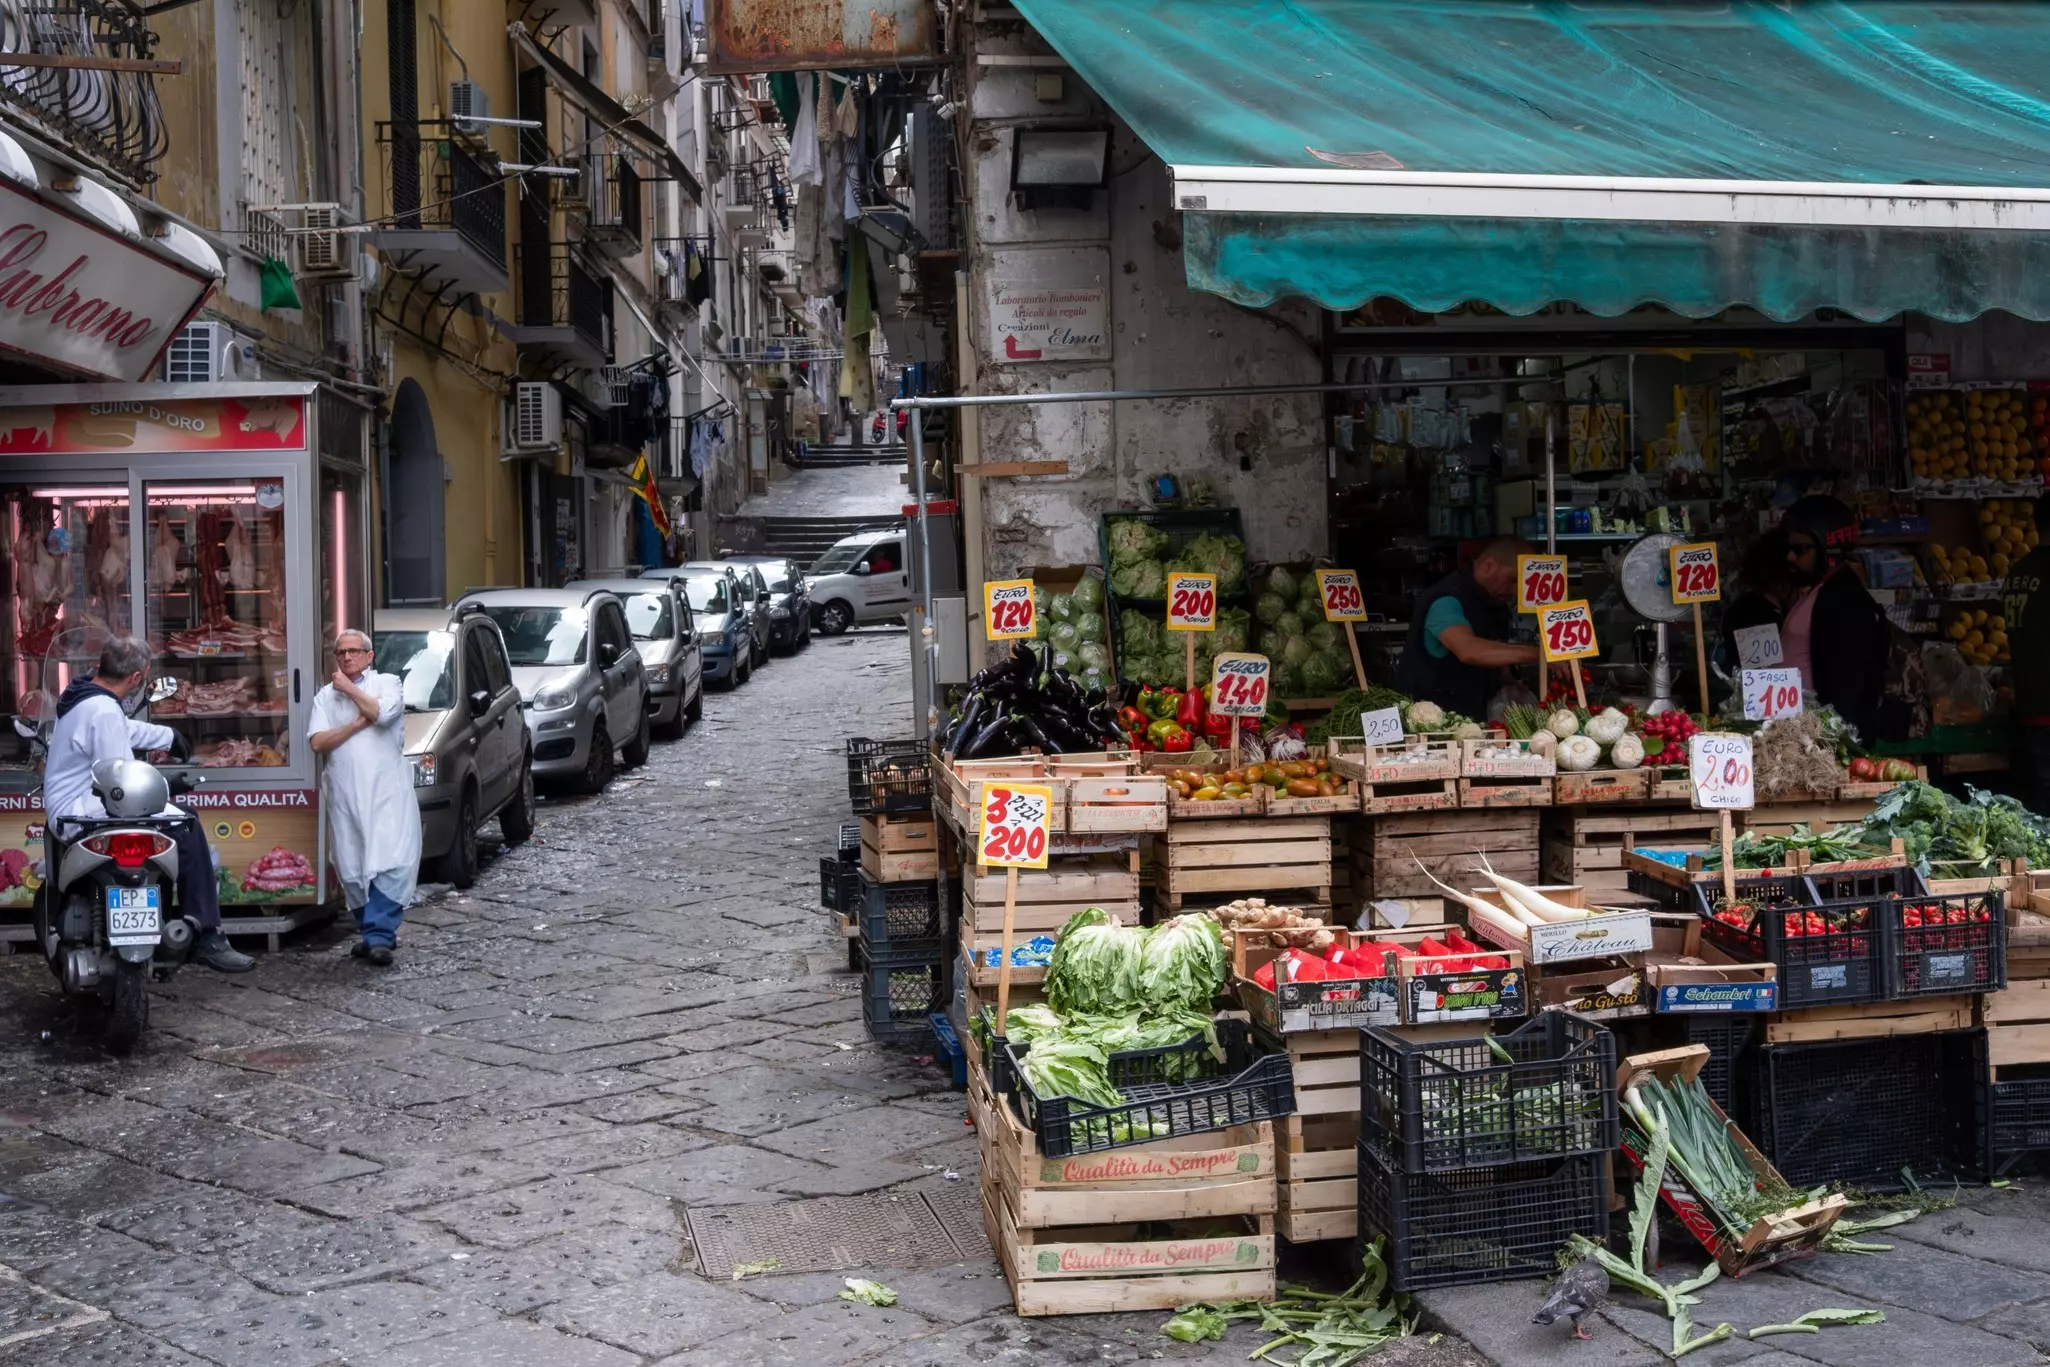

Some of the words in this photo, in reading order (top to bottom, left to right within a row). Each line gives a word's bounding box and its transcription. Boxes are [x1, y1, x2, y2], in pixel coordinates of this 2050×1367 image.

[995, 294, 1047, 306] Laboratorio
[1011, 306, 1046, 318] Articoli
[1057, 306, 1087, 319] regalo
[997, 322, 1050, 332] Creazioni
[1048, 327, 1102, 346] Elma
[89, 400, 144, 416] SUINO
[149, 403, 205, 432] D'ORO
[993, 586, 1028, 600] EURO
[1547, 606, 1586, 622] EURO
[1217, 658, 1268, 674] EURO
[1744, 671, 1755, 687] 3
[1702, 740, 1744, 754] EURO
[31, 796, 46, 809] S
[175, 794, 231, 807] PRIMA
[234, 789, 309, 807] QUALITÀ
[986, 789, 1013, 824] 3
[121, 889, 138, 907] EP
[112, 911, 157, 930] 62373
[1541, 938, 1638, 958] Château
[1063, 1155, 1139, 1182] Qualità
[1142, 1158, 1164, 1173] da
[1166, 1150, 1238, 1177] Sempre
[1061, 1244, 1136, 1271] Qualità
[1140, 1248, 1161, 1264] da
[1163, 1240, 1236, 1267] Sempre
